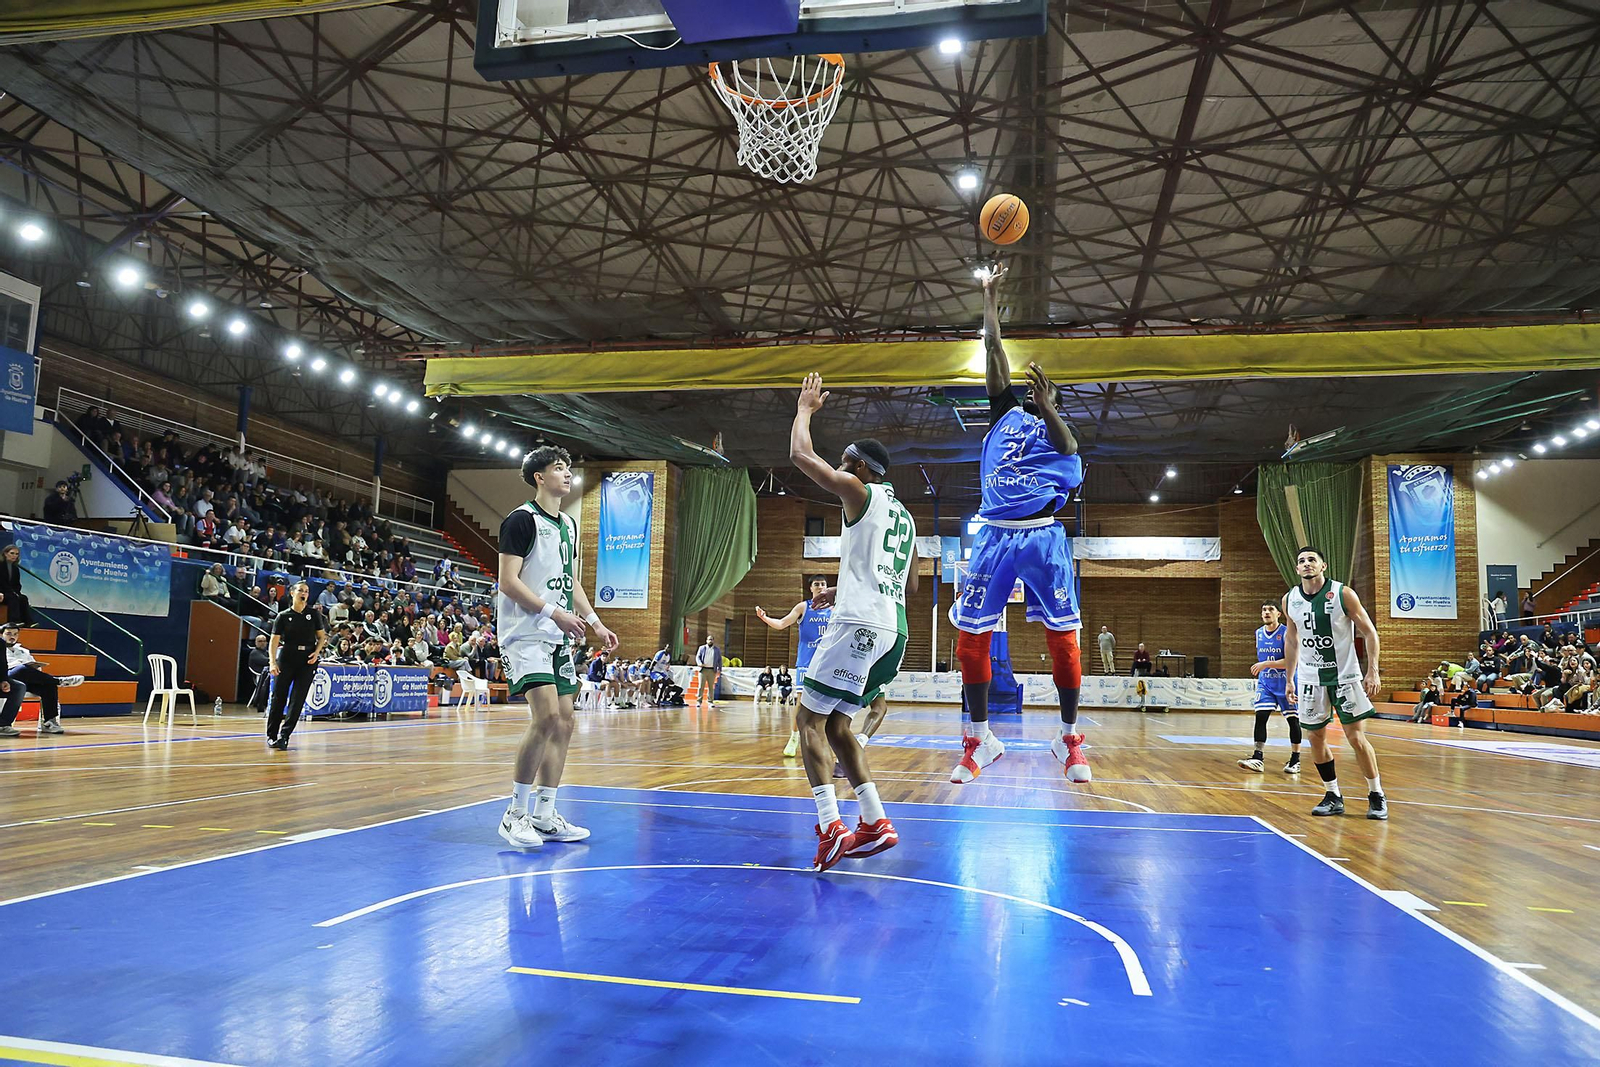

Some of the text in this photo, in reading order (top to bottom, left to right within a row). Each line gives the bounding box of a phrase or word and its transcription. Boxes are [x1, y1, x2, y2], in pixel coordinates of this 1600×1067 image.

[21, 481, 35, 490] 117
[882, 508, 911, 561] 22
[1399, 534, 1448, 547] Apoyamos
[1400, 543, 1449, 557] tu esfuerzo
[79, 557, 129, 571] Ayuntamiento
[93, 567, 128, 578] de Huelva
[963, 583, 987, 610] 23
[1303, 612, 1317, 630] 21
[1302, 635, 1333, 648] coto
[332, 673, 374, 685] Ayuntamiento
[393, 674, 428, 684] Ayuntamiento
[833, 668, 867, 684] efficold
[343, 683, 374, 691] de Huelva
[402, 683, 428, 691] de Huelva
